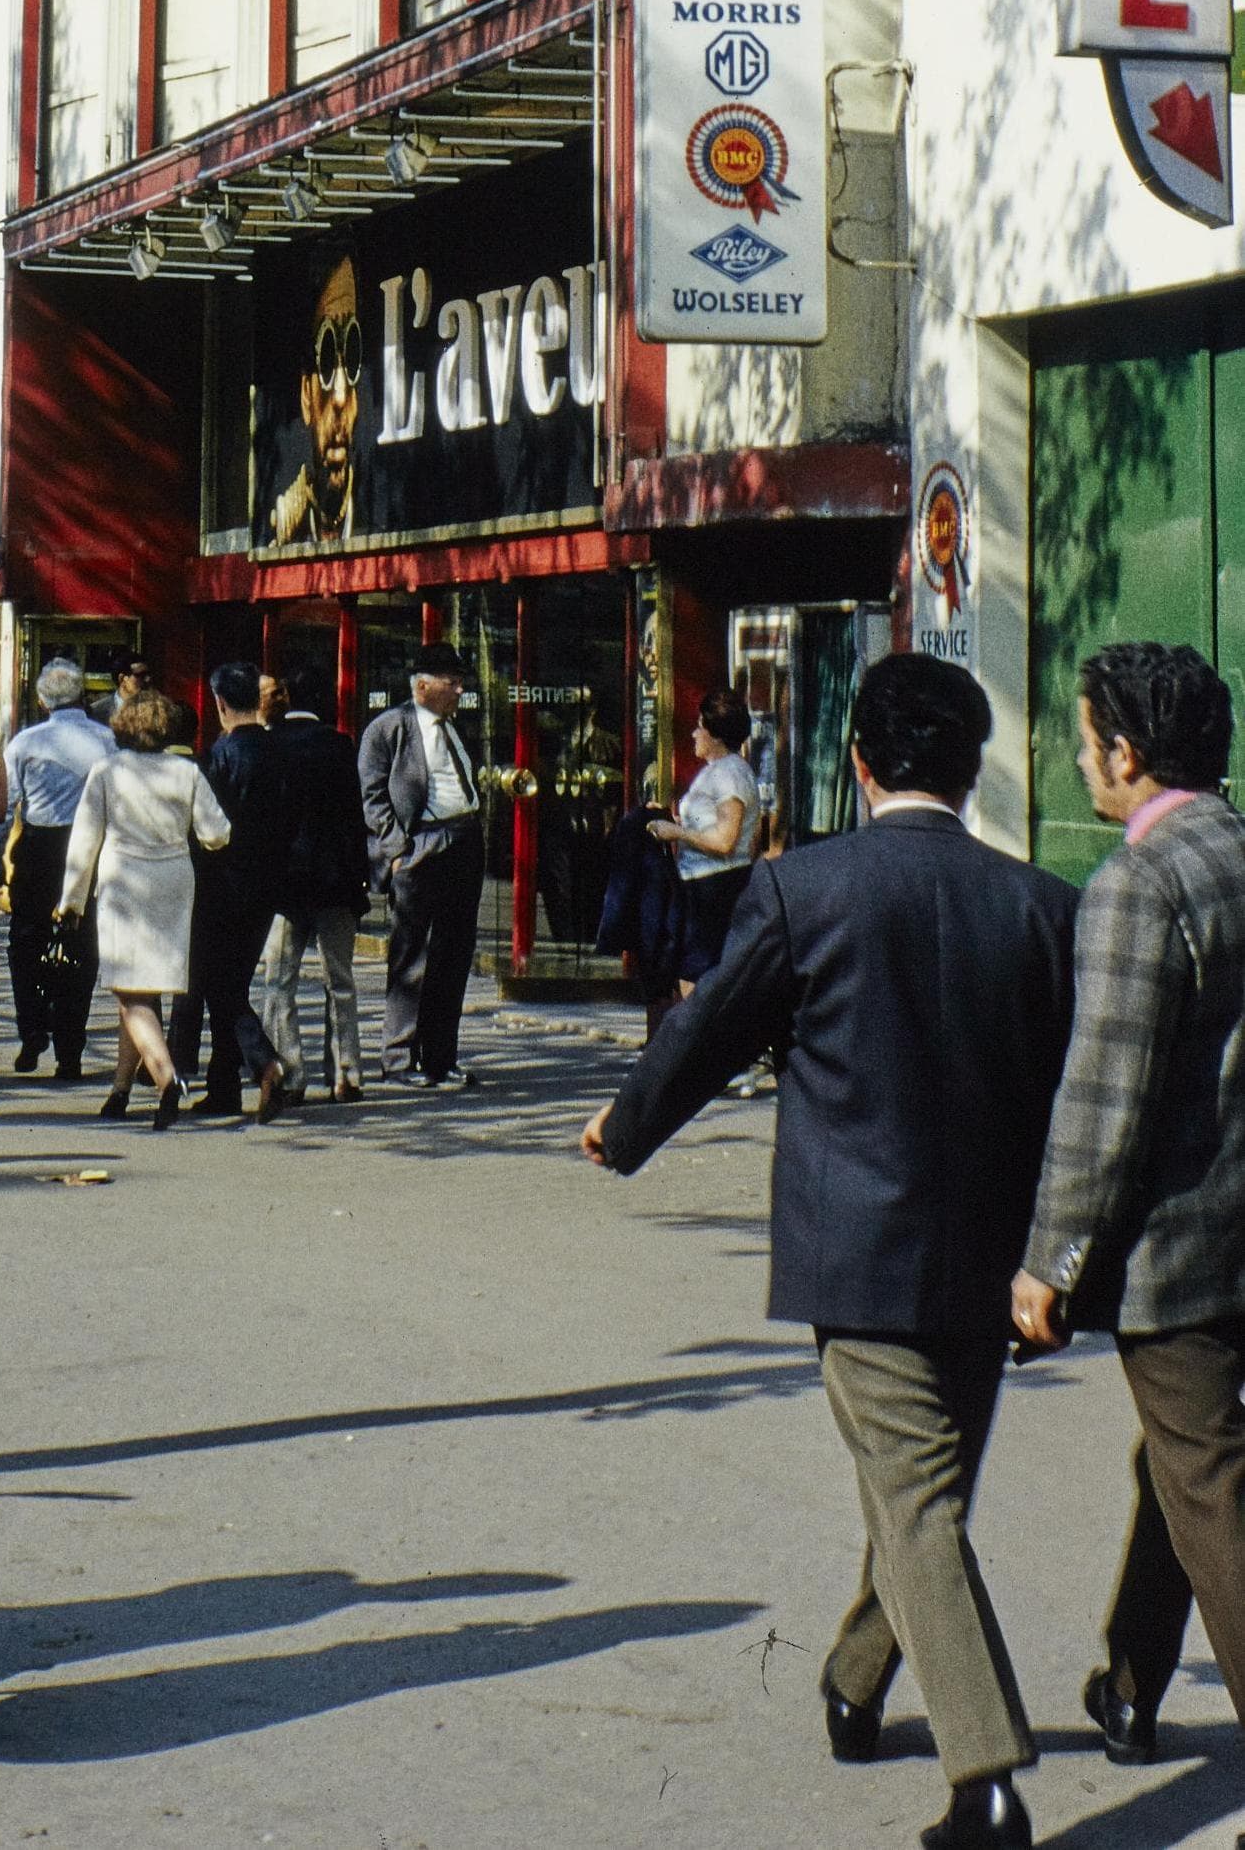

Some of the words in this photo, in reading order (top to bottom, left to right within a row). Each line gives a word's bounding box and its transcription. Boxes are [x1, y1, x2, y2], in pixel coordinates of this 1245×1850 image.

[673, 1, 802, 25] MORRIS
[713, 39, 761, 87] MG
[717, 150, 759, 166] BMC
[707, 230, 770, 269] Riley
[672, 288, 804, 315] WOLSELEY
[377, 260, 607, 445] L'aveu
[932, 520, 956, 538] BMC
[921, 629, 968, 658] SERVICE
